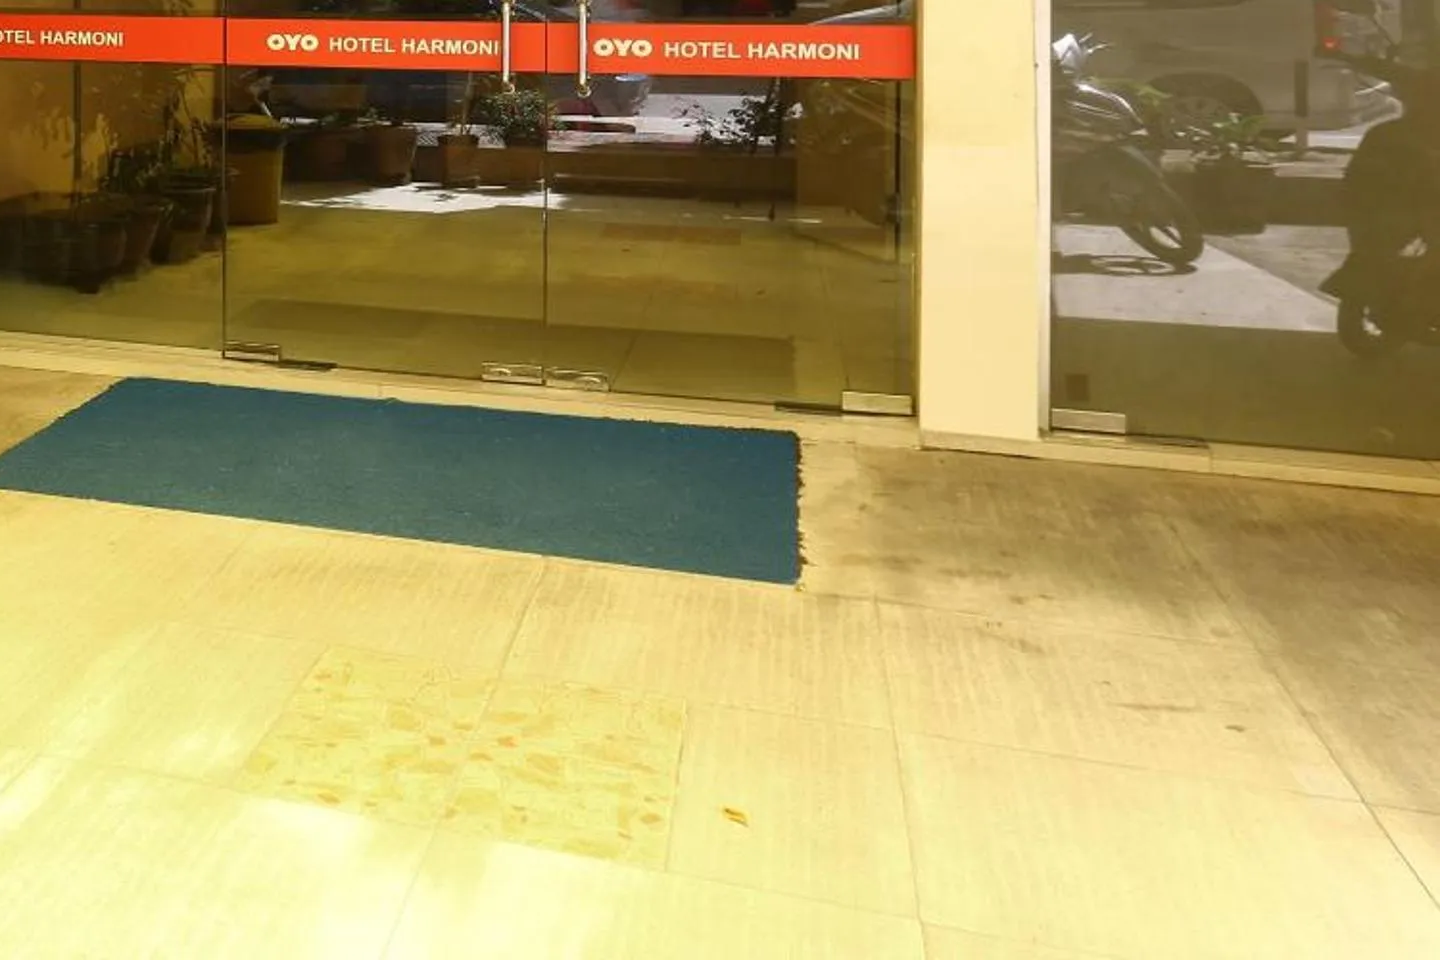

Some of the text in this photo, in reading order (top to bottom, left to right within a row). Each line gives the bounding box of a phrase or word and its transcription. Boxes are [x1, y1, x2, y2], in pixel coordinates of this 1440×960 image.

[40, 30, 124, 47] HARMONI
[266, 33, 499, 55] OYO HOTEL HARMONI
[593, 38, 860, 60] OYO HOTEL HARMONI
